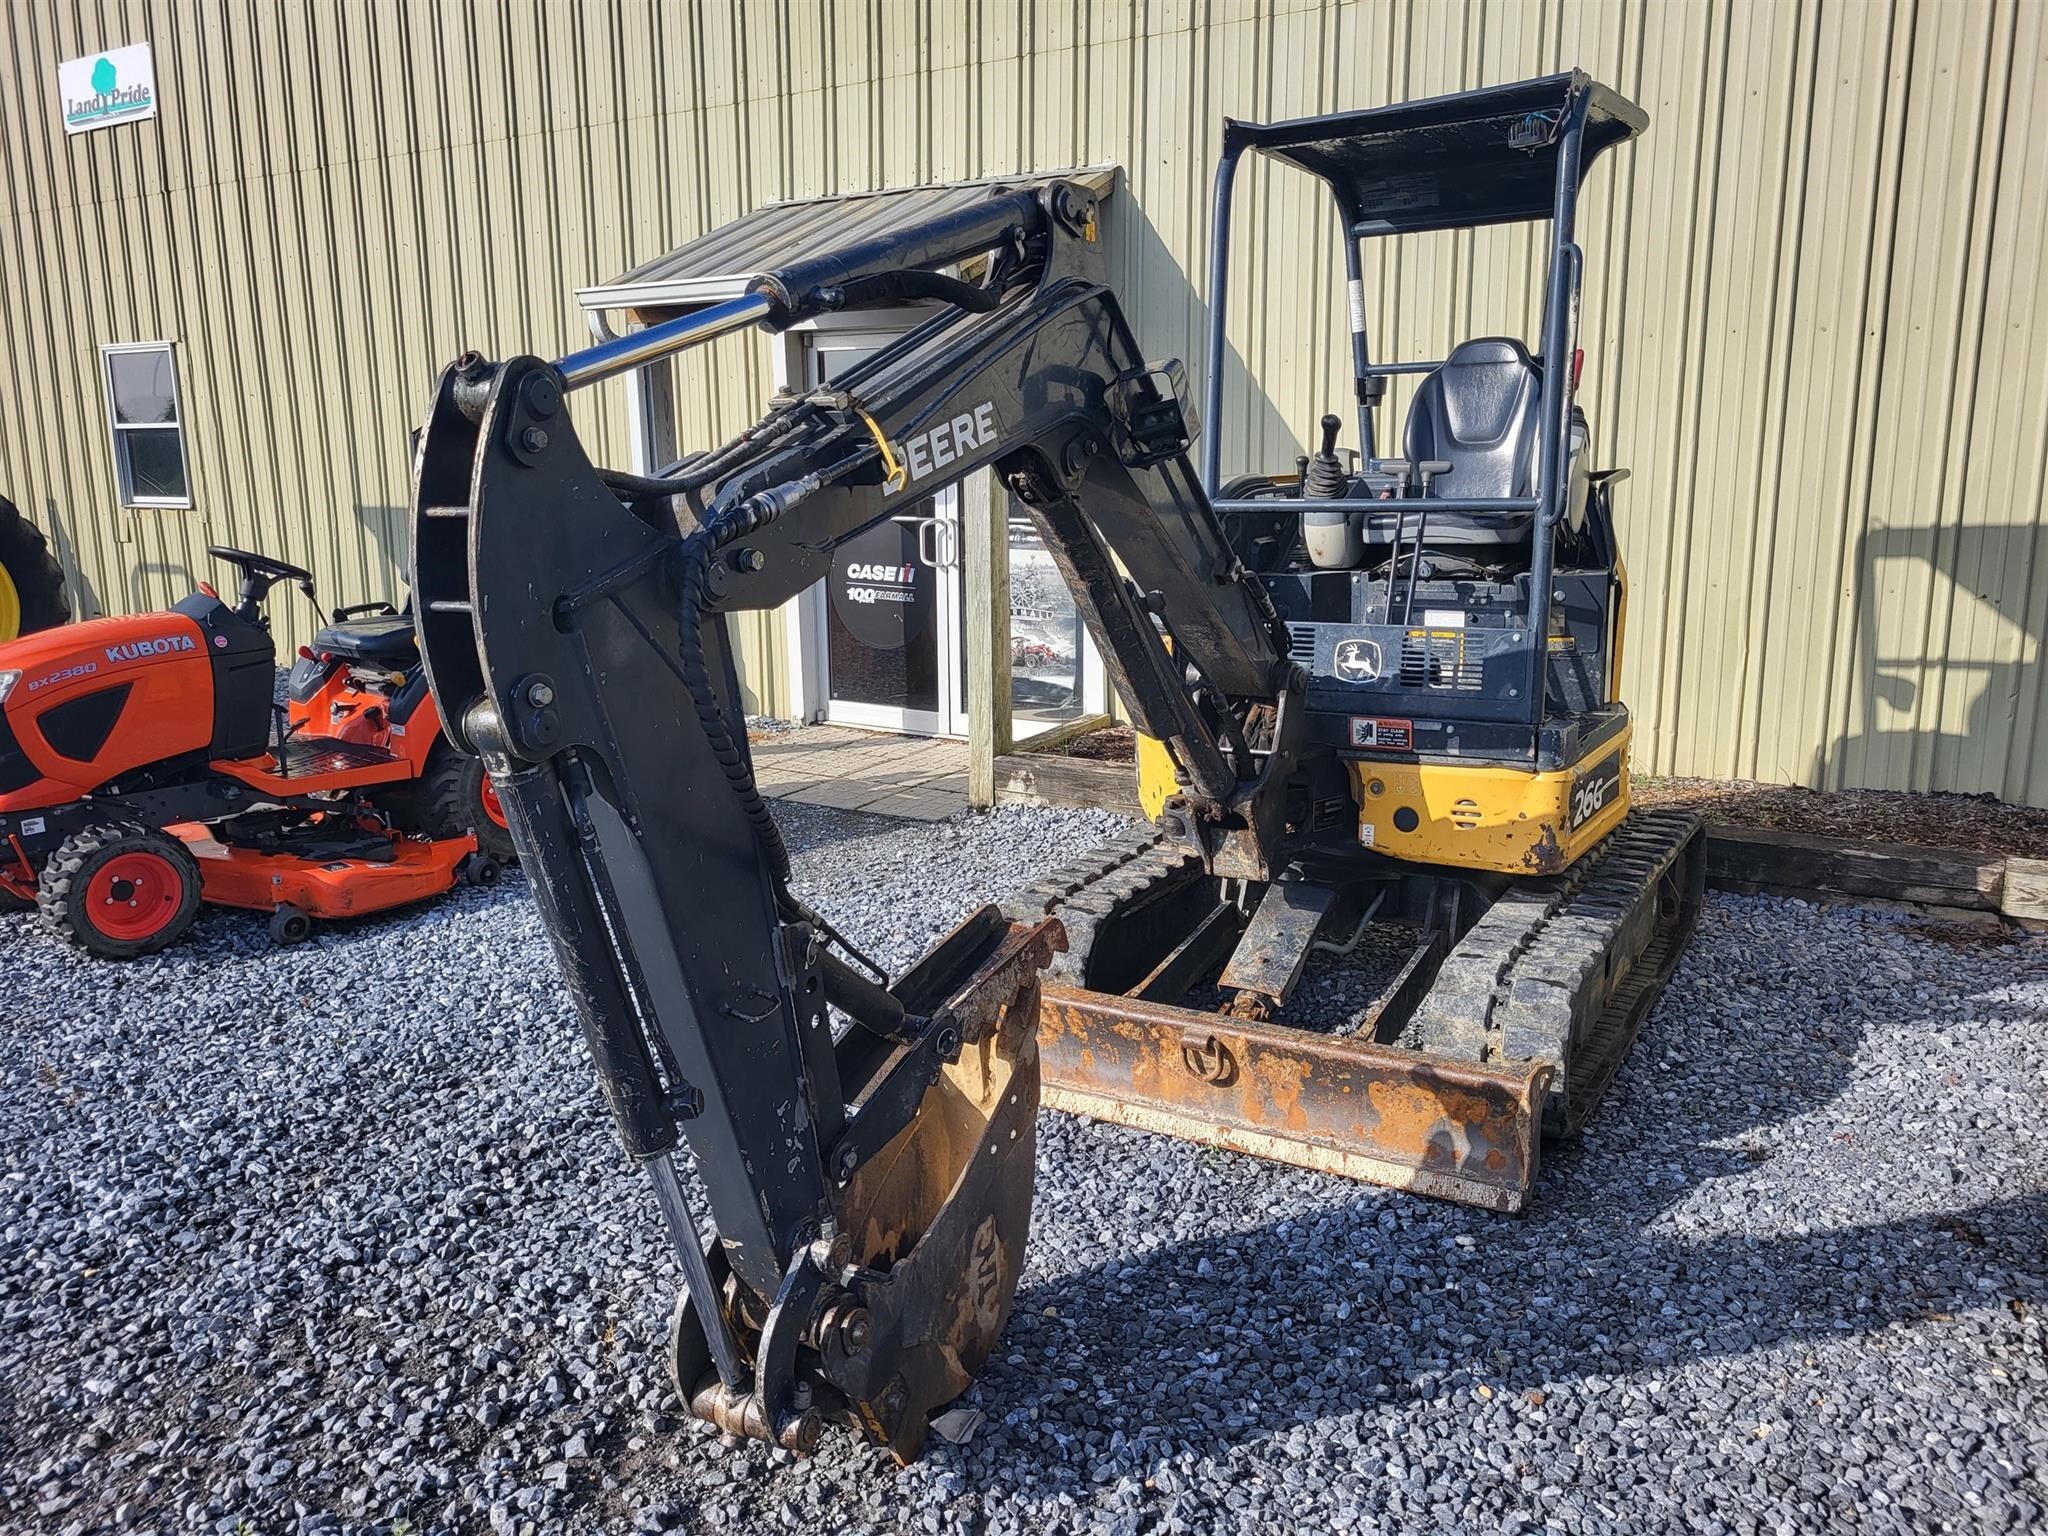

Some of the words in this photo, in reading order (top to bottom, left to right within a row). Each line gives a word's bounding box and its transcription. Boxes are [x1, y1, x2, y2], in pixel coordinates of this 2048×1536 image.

[68, 93, 100, 116] Land
[111, 83, 150, 107] Pride
[846, 563, 898, 582] CASE
[846, 587, 876, 602] 100
[105, 635, 197, 663] KUBOTA
[28, 662, 97, 692] BX2380
